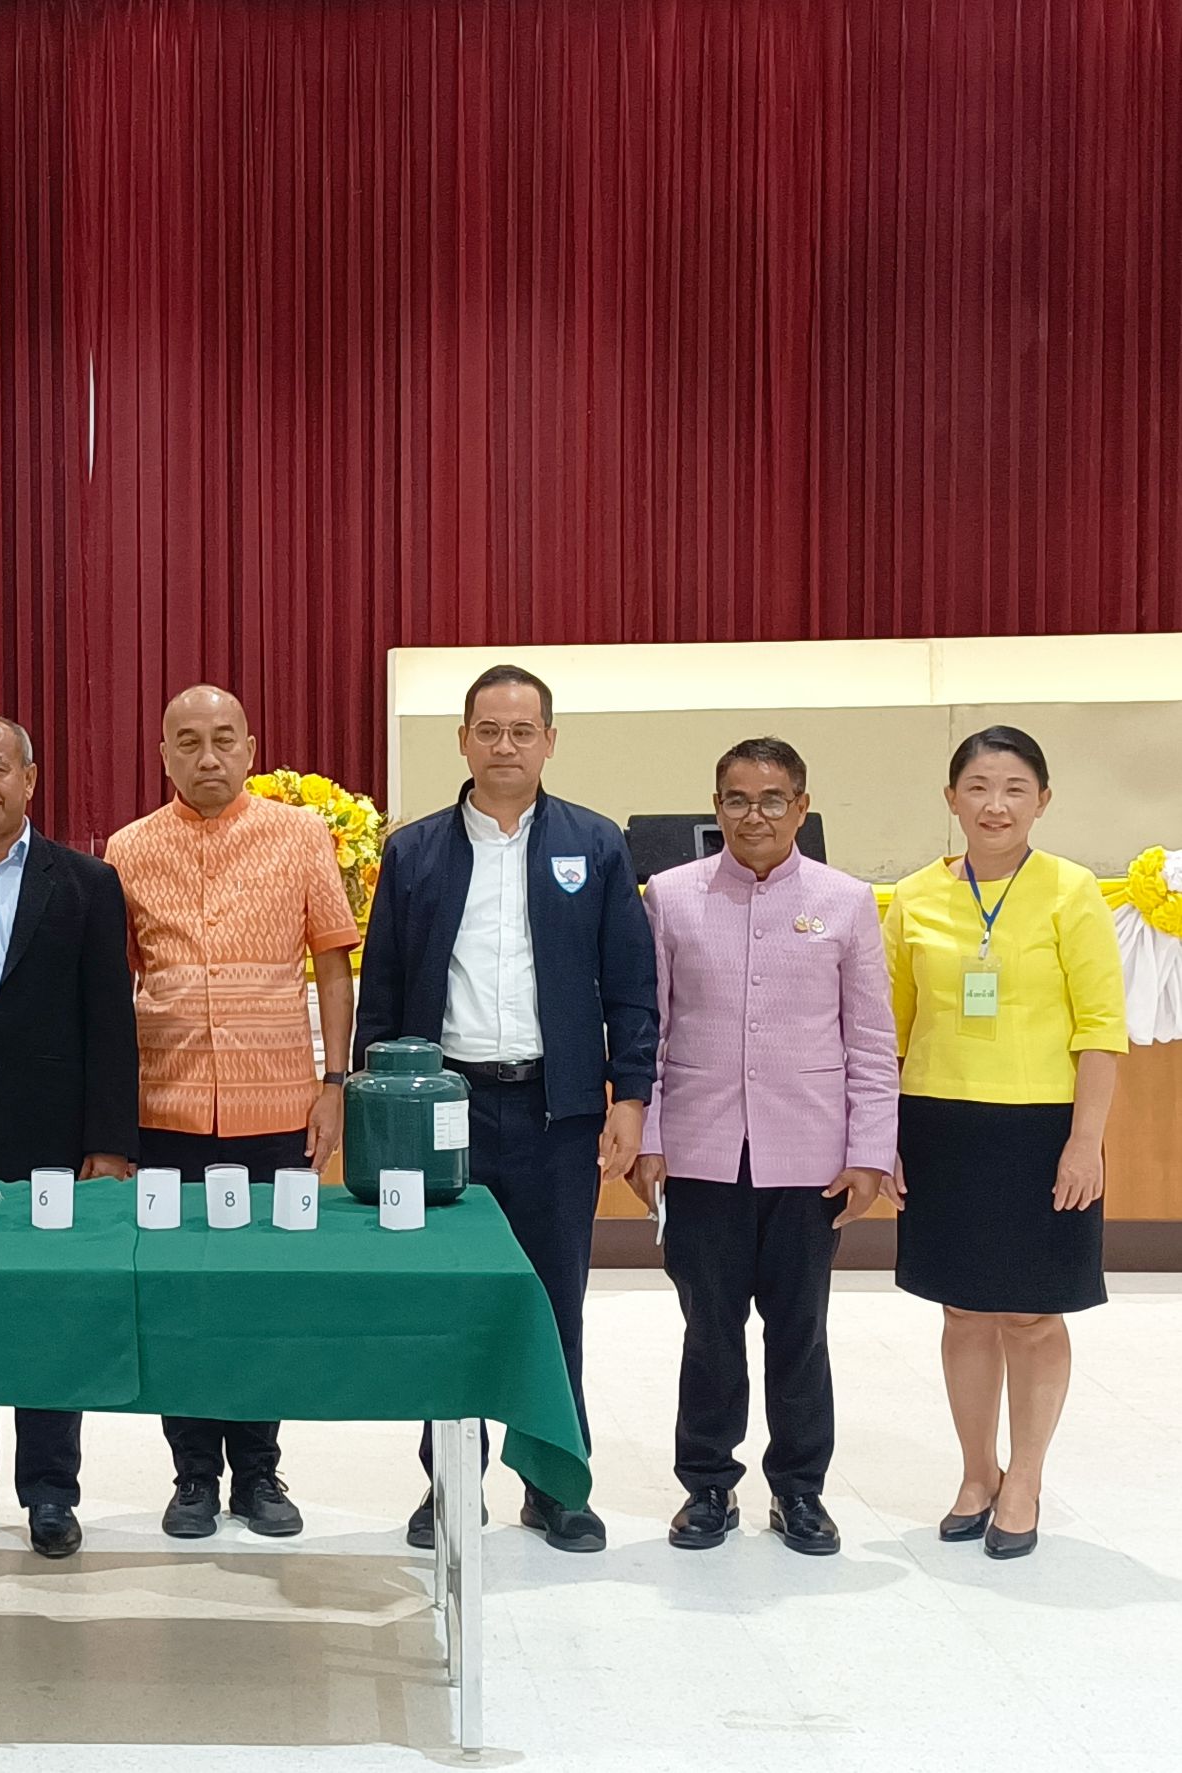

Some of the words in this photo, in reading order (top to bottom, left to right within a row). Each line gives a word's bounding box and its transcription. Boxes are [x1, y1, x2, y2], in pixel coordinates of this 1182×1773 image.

[38, 1190, 48, 1206] 6
[146, 1194, 156, 1210] 7
[224, 1191, 235, 1207] 8
[301, 1195, 311, 1211] 9
[382, 1189, 400, 1206] 10
